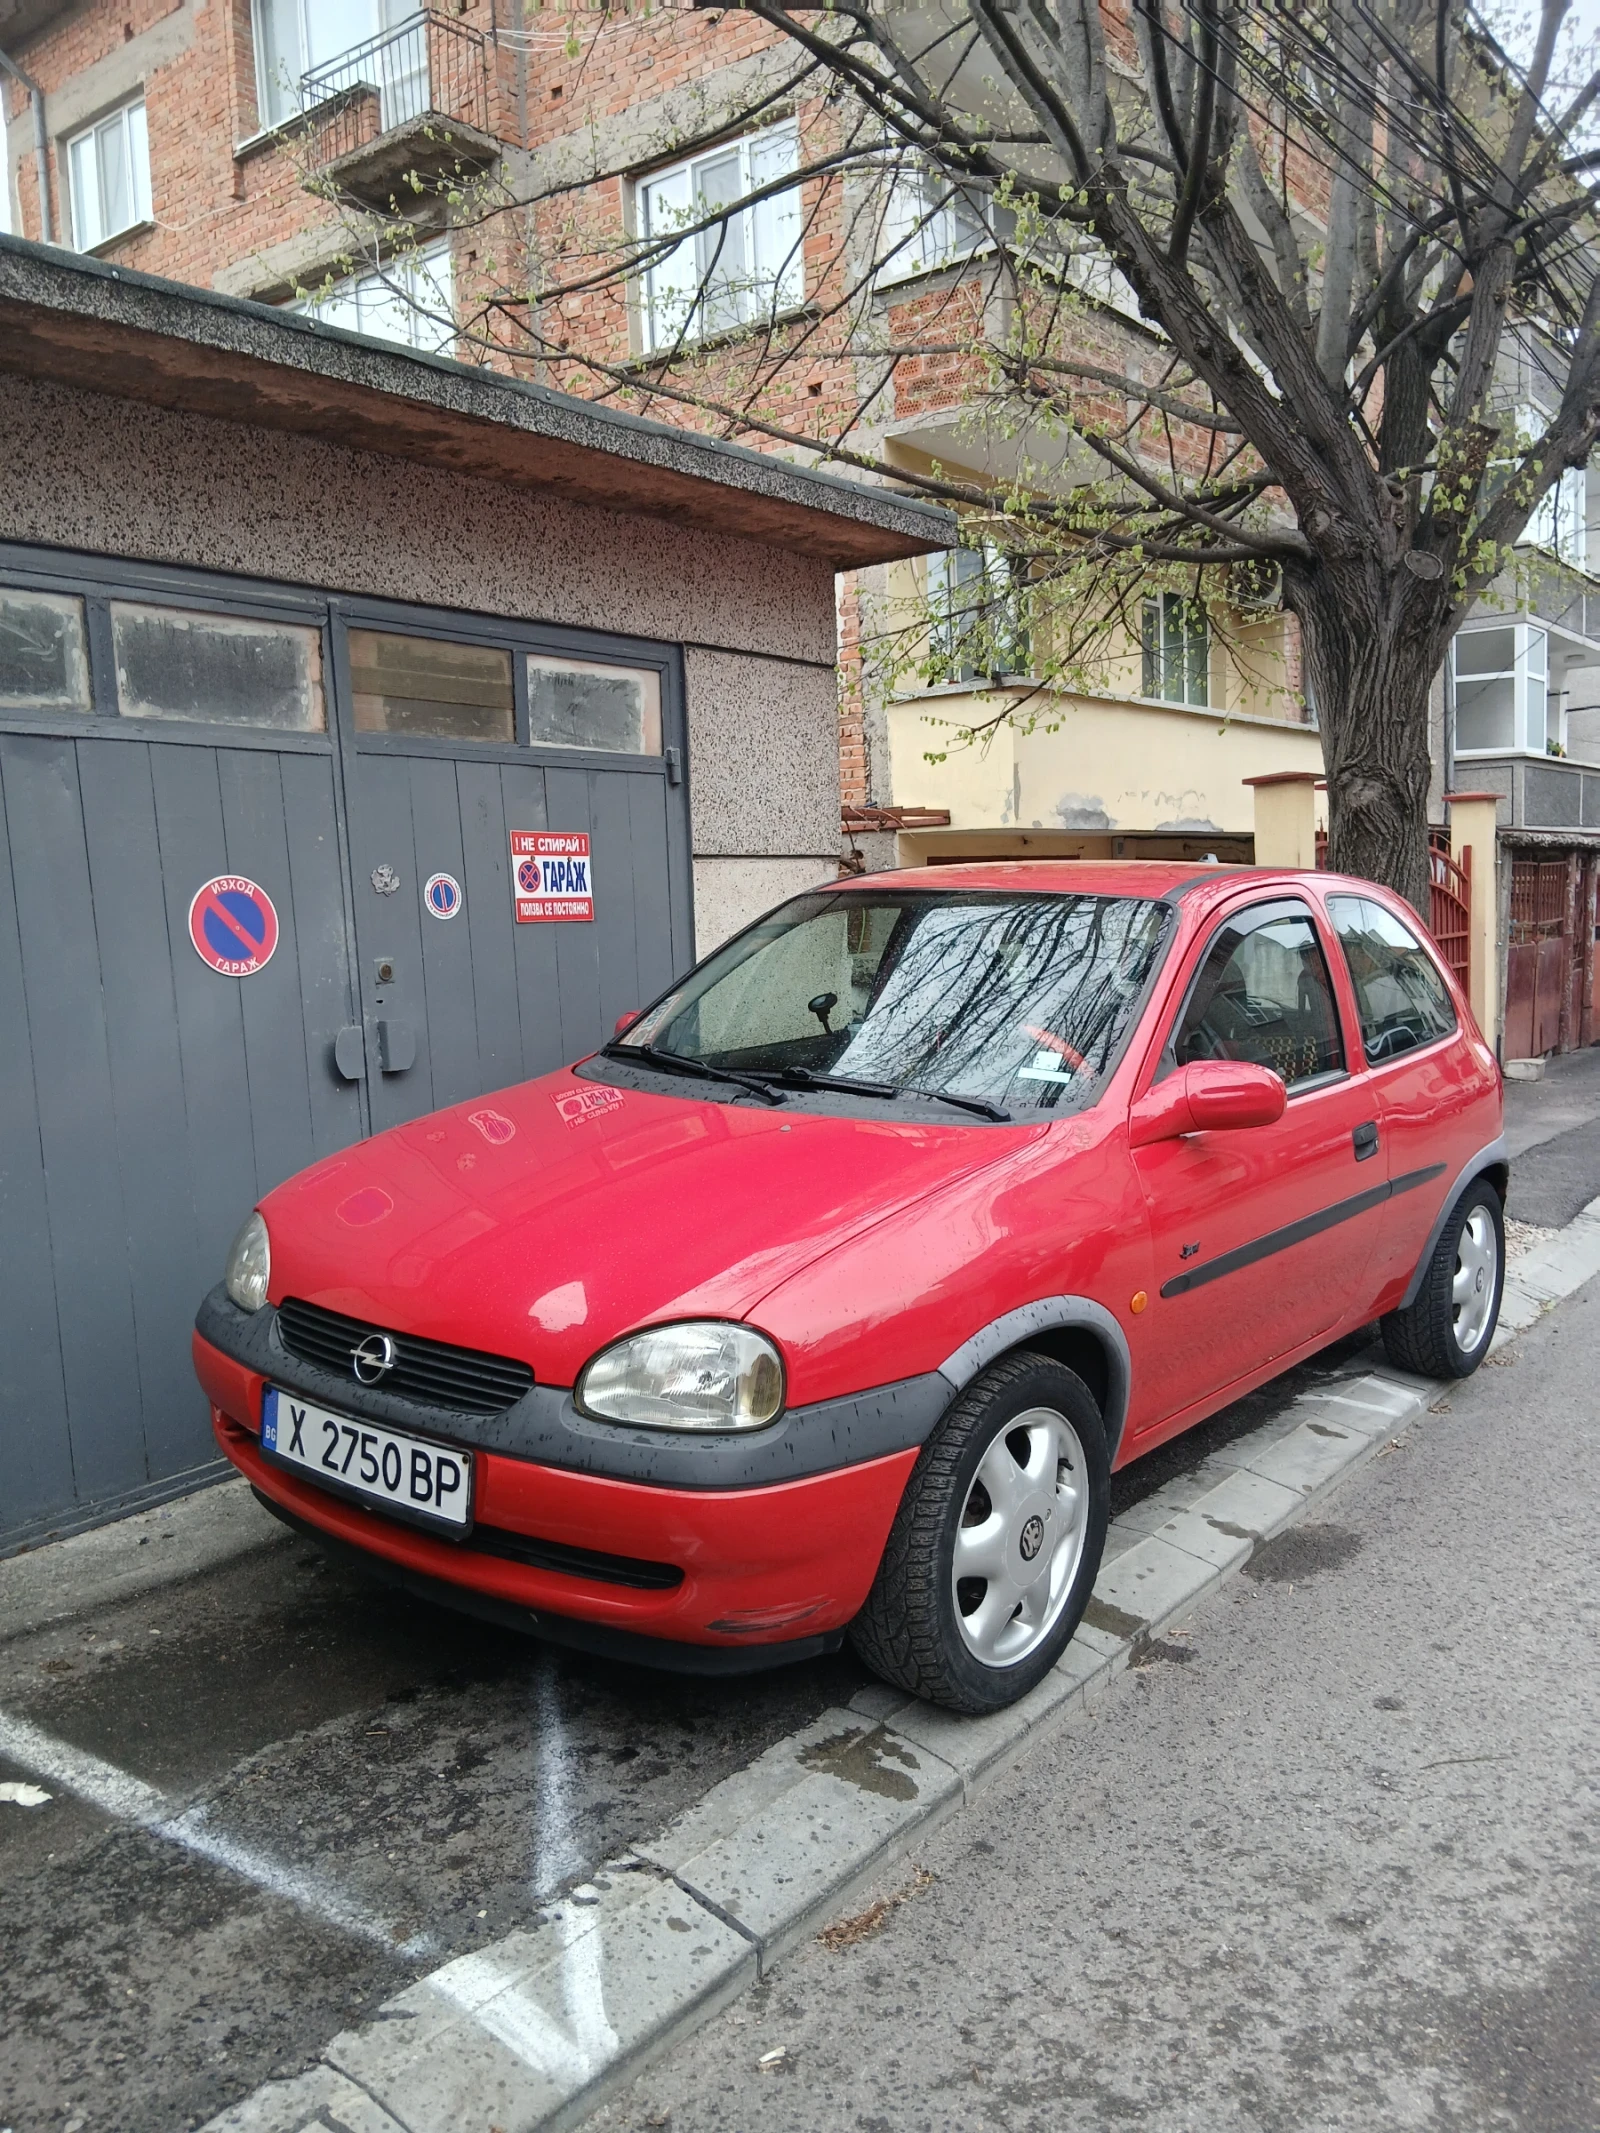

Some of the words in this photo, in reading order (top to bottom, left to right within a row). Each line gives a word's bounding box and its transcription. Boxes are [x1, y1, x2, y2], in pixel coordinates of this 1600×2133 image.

[521, 837, 535, 851] НЕ
[538, 836, 579, 852] СПИРАЙ
[543, 861, 587, 892] ГАРАЖ
[210, 879, 255, 898] ИЗХОД
[544, 902, 552, 915] СЕ
[215, 956, 260, 973] ГАРАЖ
[265, 1424, 276, 1442] BG
[289, 1404, 306, 1458] X
[322, 1420, 402, 1492] 2750
[410, 1448, 461, 1507] BP
